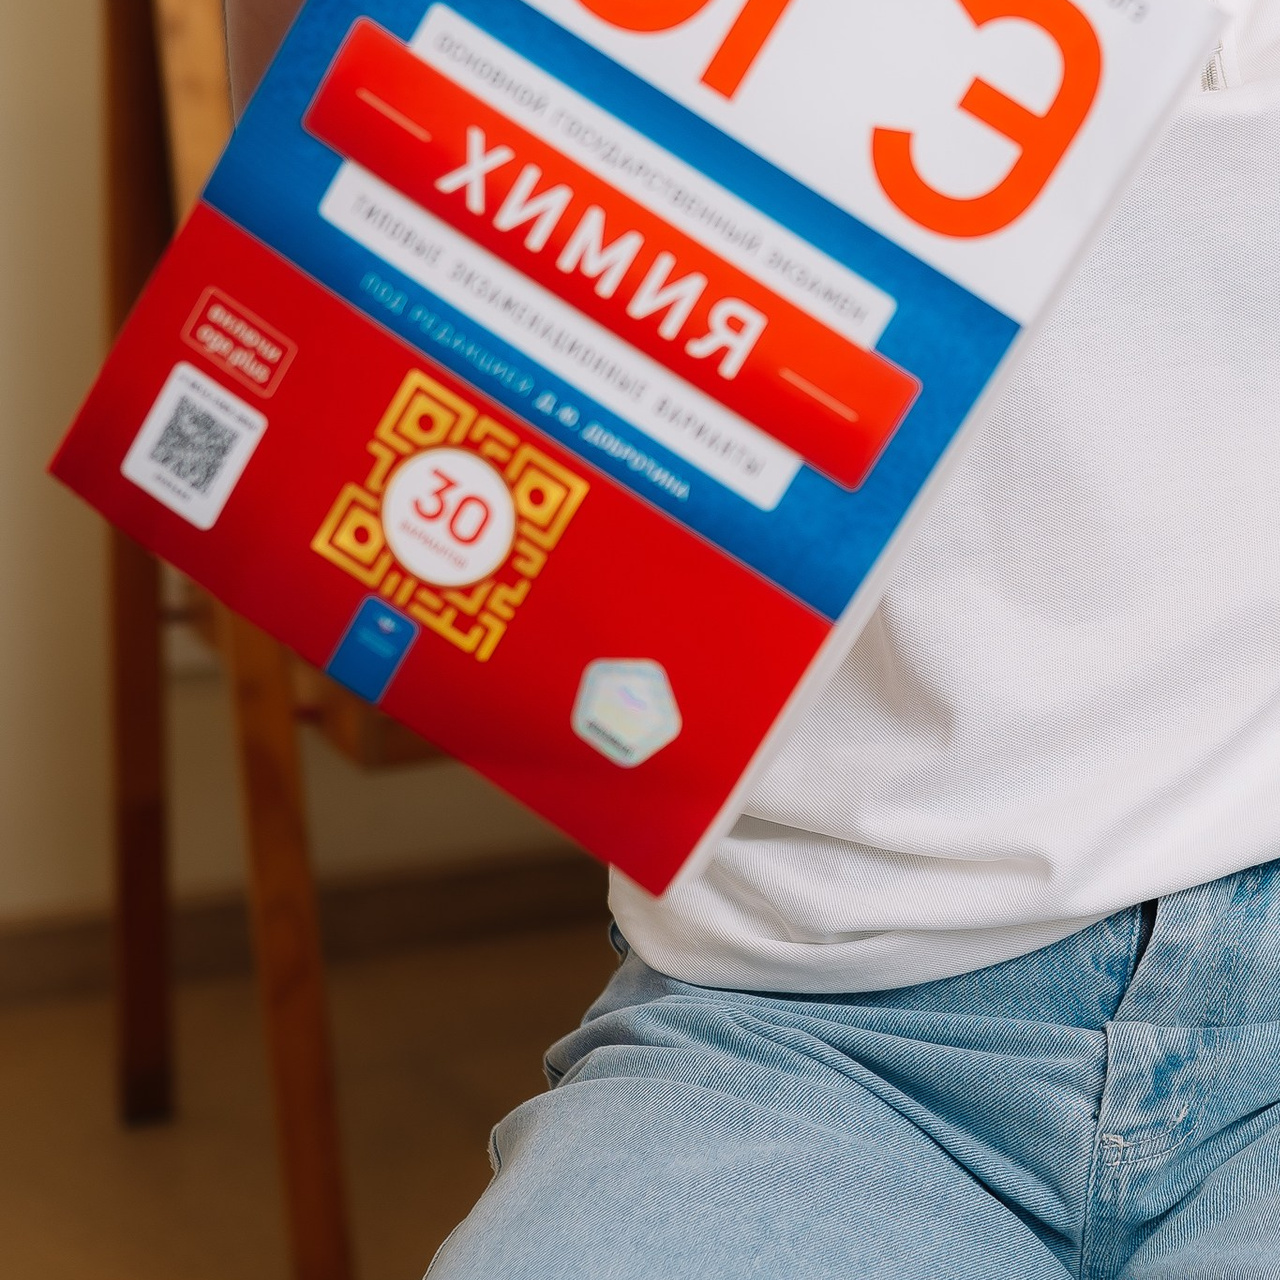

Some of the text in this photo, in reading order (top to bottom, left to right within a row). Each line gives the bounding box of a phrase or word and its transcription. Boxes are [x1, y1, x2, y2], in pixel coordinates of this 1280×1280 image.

[433, 124, 770, 382] ХИМИЯ
[434, 31, 870, 323] ОСНОВНОЙ ГОСУДАРСТВЕННЫЙ ЭКЗАМЕН
[204, 302, 285, 364] включи
[352, 193, 766, 479] ТИПОВЫЕ ЭКЗАМЕНАЦИОННЫЕ ВАРИАНТЫ
[361, 273, 408, 314] ПОД
[407, 305, 535, 397] РЕДАКЦИЕЙ
[579, 420, 695, 502] ДОБРОТИНА
[409, 466, 496, 549] 30
